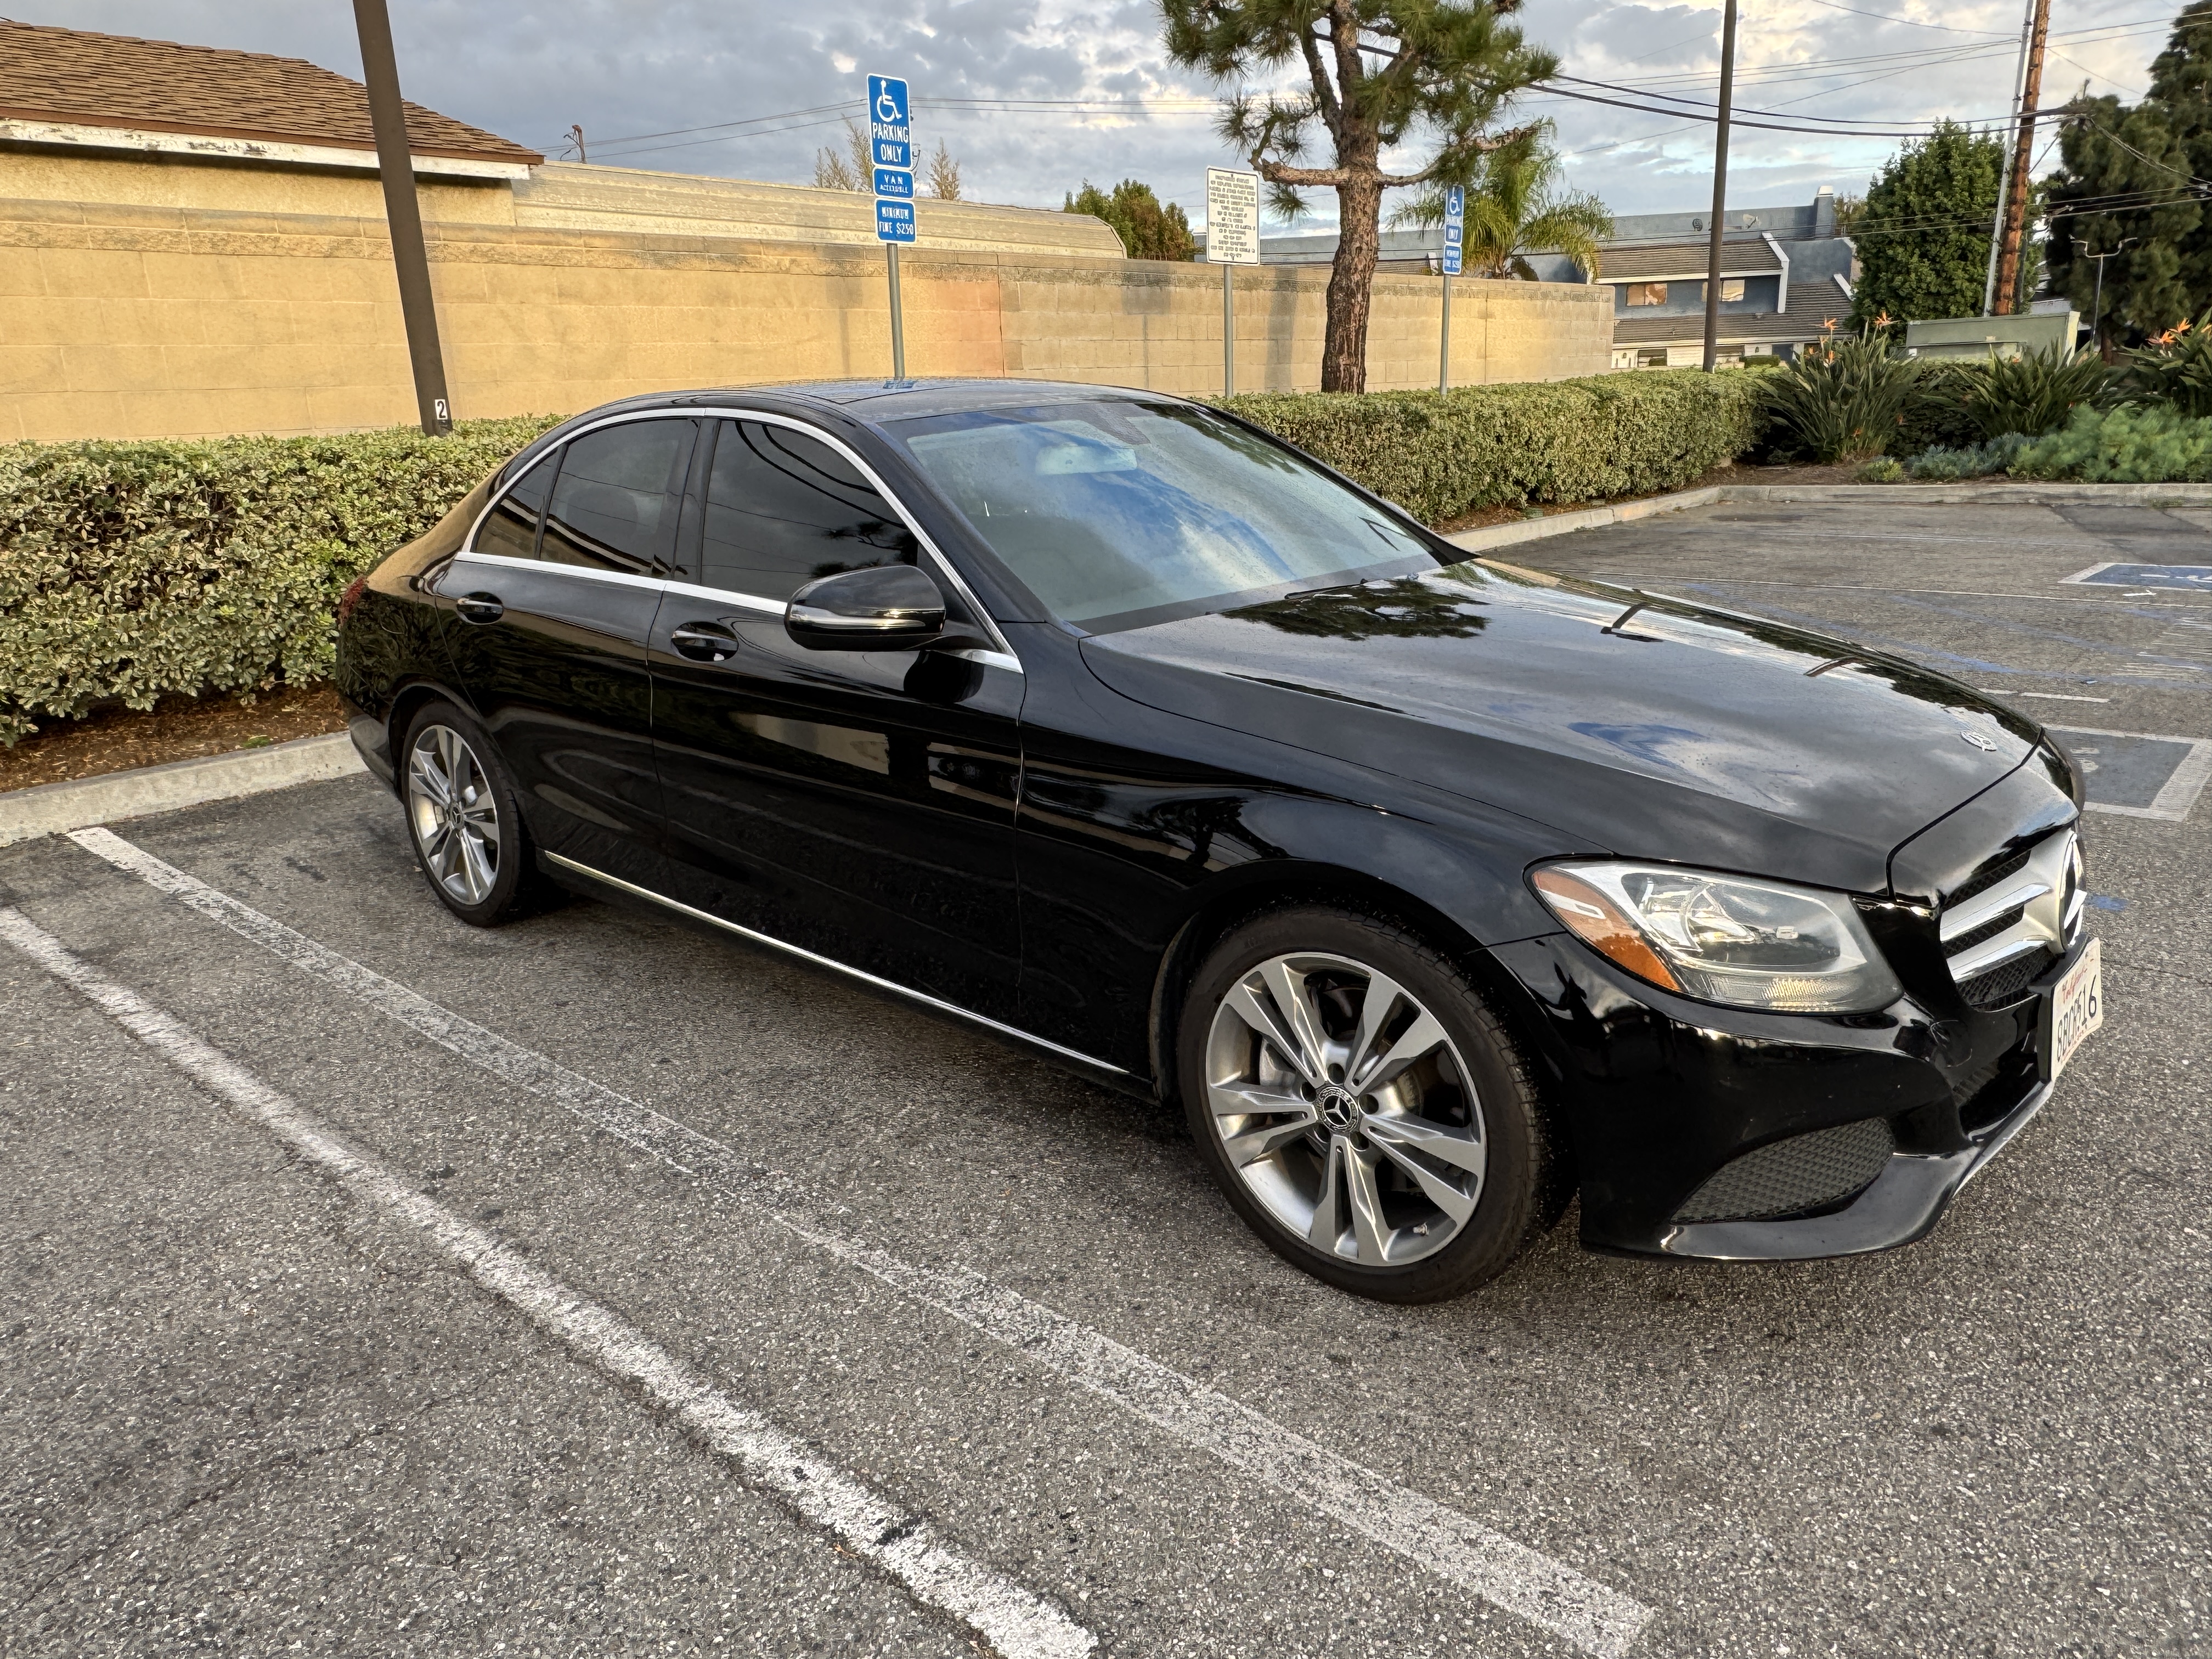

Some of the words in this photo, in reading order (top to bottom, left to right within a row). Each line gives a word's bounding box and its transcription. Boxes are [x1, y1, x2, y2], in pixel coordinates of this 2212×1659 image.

[872, 122, 909, 143] PARKING
[881, 144, 902, 163] ONLY
[884, 174, 903, 185] VAN
[896, 222, 914, 235] $250
[437, 400, 446, 419] 2
